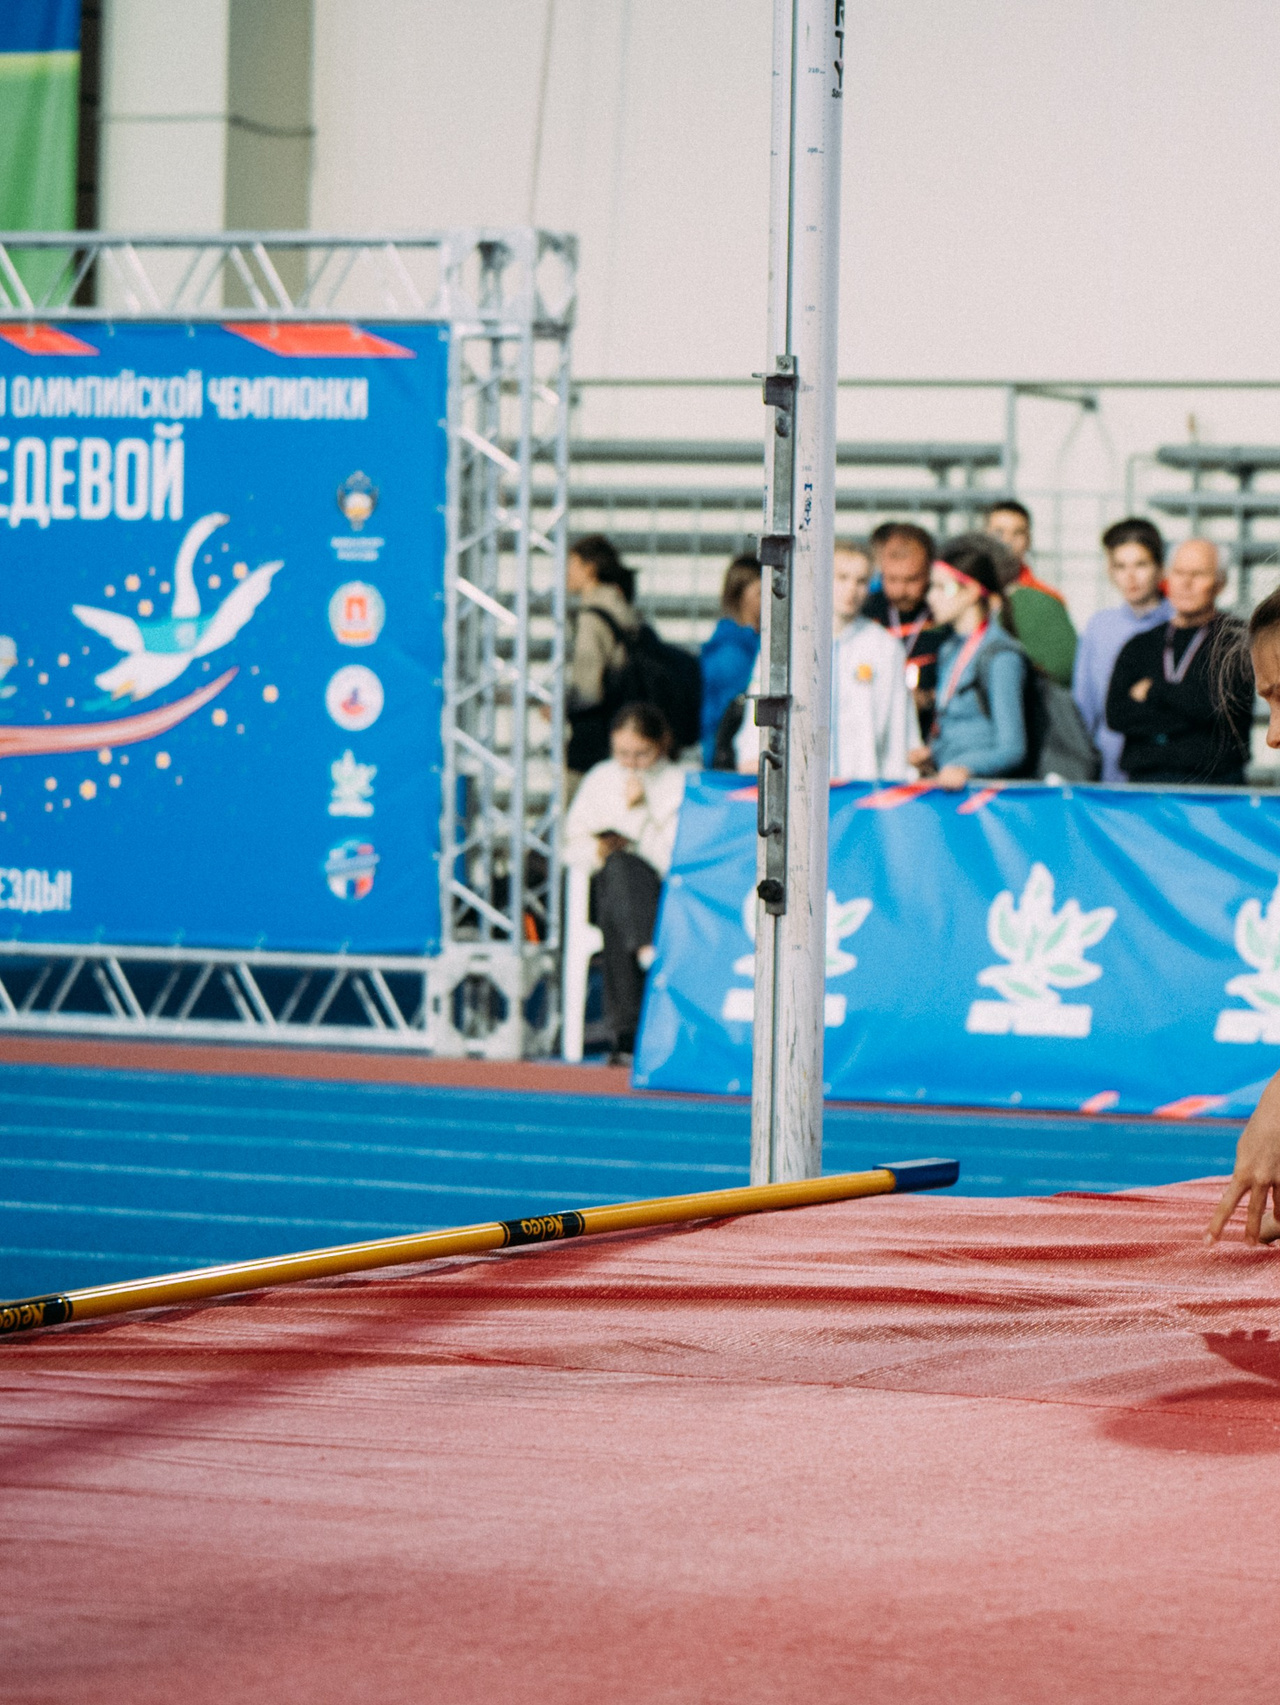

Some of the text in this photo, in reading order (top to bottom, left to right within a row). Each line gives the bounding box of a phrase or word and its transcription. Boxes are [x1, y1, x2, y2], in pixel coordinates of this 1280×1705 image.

[11, 368, 203, 419] ОЛИМПИЙСКОЙ
[207, 376, 369, 420] ЧЕМПИОНКИ
[521, 1214, 567, 1239] Nelco
